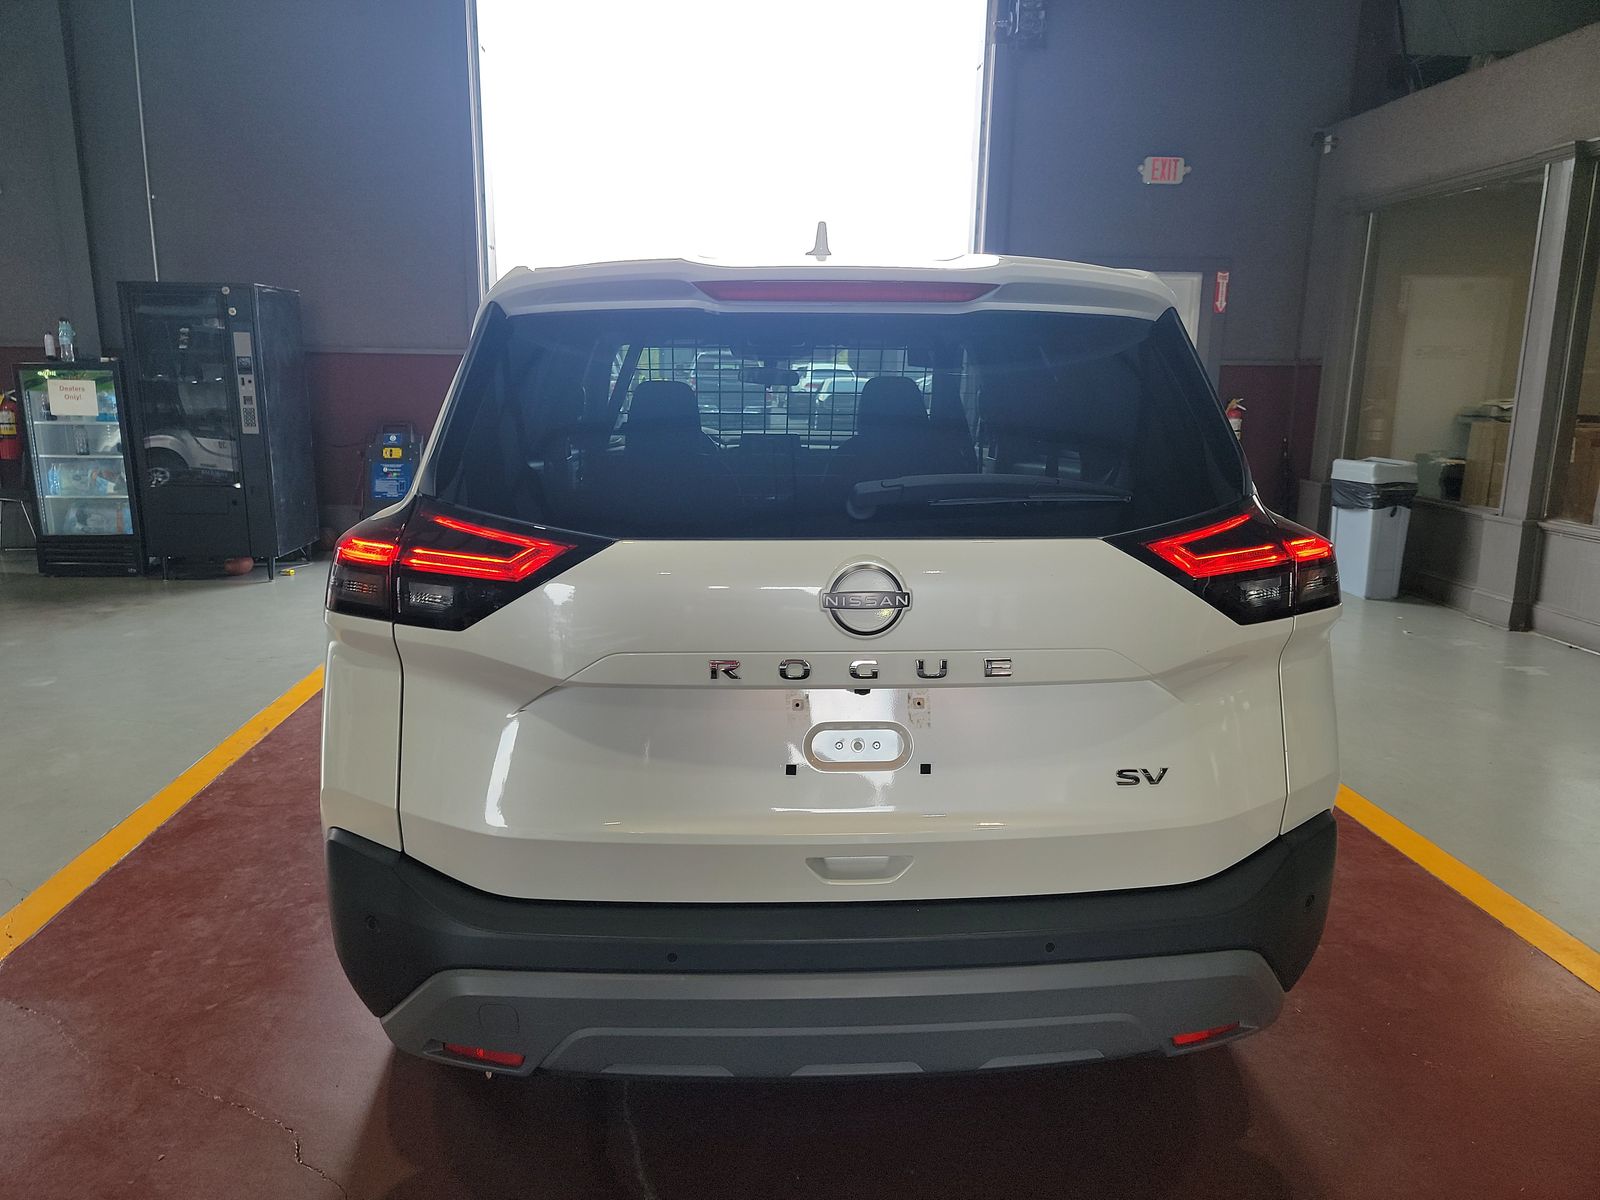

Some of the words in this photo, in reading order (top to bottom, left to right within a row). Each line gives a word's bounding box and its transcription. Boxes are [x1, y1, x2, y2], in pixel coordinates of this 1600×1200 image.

[1151, 157, 1180, 180] EXIT
[825, 595, 908, 607] NISSAN
[709, 656, 1013, 681] ROGUE
[1116, 767, 1169, 786] SV
